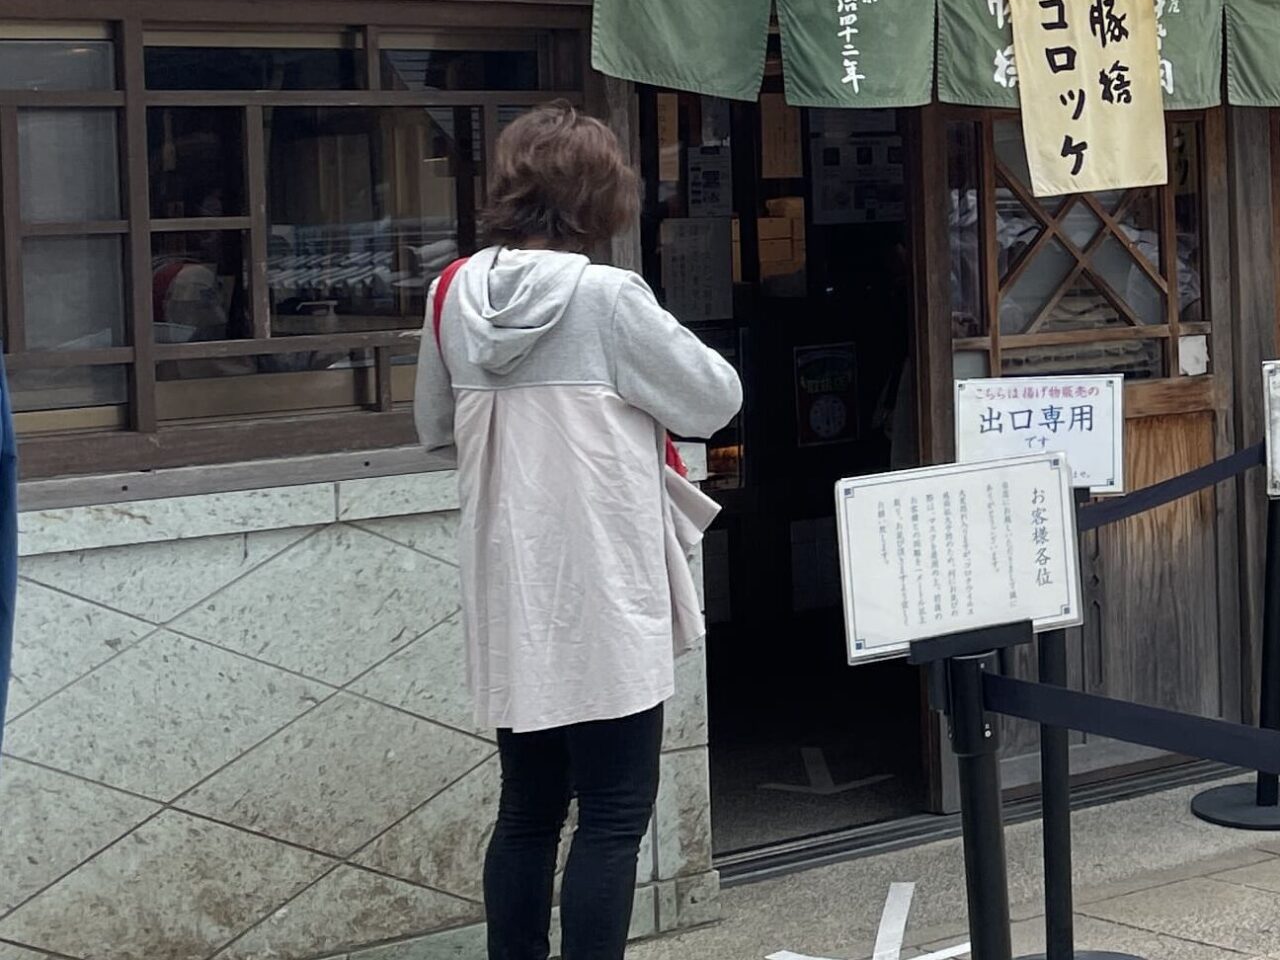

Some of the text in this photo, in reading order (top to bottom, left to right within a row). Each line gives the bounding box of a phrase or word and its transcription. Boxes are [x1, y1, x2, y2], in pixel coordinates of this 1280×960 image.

[975, 385, 1100, 401] こちらは揚げ物販売の
[979, 404, 1094, 434] 出口専用
[1024, 435, 1050, 449] です
[1030, 486, 1054, 588] お客様各位
